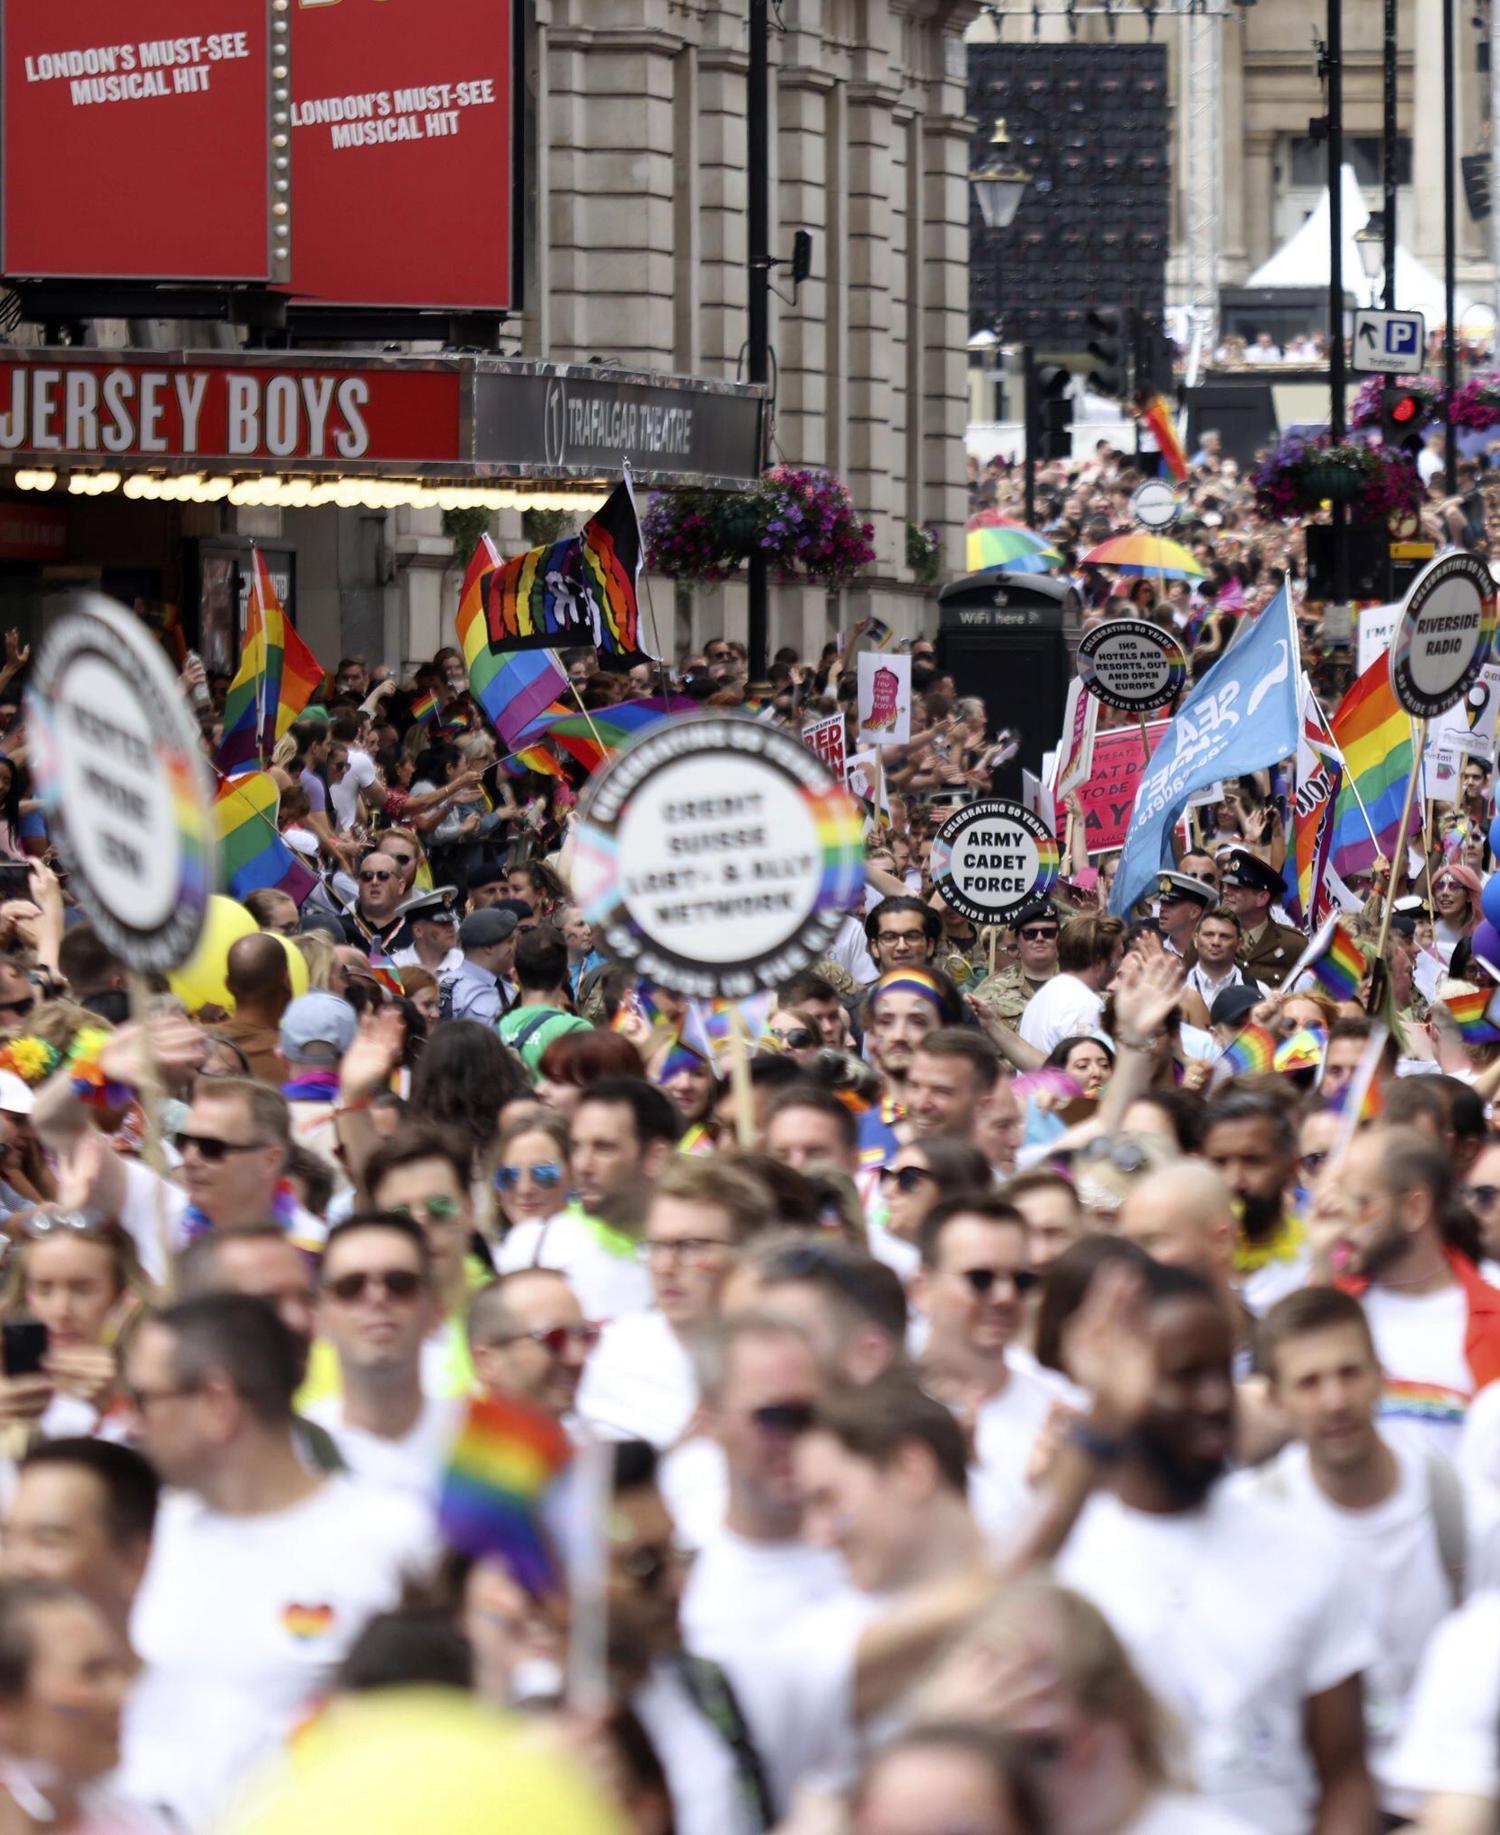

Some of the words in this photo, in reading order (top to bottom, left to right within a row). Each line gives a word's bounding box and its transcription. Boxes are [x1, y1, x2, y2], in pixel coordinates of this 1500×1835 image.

[24, 45, 136, 82] LONDON'S
[138, 32, 249, 68] MUST-SEE
[70, 70, 170, 106] MUSICAL
[172, 65, 210, 94] HIT
[290, 92, 390, 127] LONDON'S
[393, 79, 495, 114] MUST-SEE
[330, 115, 423, 149] MUSICAL
[424, 110, 460, 137] HIT
[1391, 322, 1412, 352] P
[0, 368, 208, 453] JERSEY
[227, 374, 370, 459] BOYS
[568, 398, 637, 450] TRAFALGAR
[639, 405, 693, 454] THEATRE
[959, 612, 989, 625] WiFi
[995, 612, 1025, 625] here
[1416, 613, 1480, 636] RIVERSIDE
[1098, 652, 1137, 661] HOTELS
[1140, 651, 1161, 659] AND
[1118, 642, 1137, 650] IHG
[1425, 637, 1463, 657] RADIO
[1095, 662, 1145, 671] RESORTS,
[1147, 661, 1168, 669] OUT
[1107, 672, 1129, 681] AND
[1131, 671, 1159, 680] OPEN
[1114, 681, 1157, 691] EUROPE
[803, 724, 842, 751] RED
[1082, 788, 1105, 800] TO
[1109, 782, 1129, 796] BE
[662, 793, 764, 823] CREDIT
[943, 803, 1005, 838] CELEBRATING
[1007, 804, 1022, 817] 50
[1022, 812, 1048, 841] YEARS
[669, 828, 765, 854] SUISSE
[967, 831, 1024, 848] ARMY
[751, 855, 812, 881] ALLY
[963, 854, 1027, 870] CADET
[963, 876, 1026, 893] FORCE
[655, 891, 794, 927] NETWORK
[941, 885, 954, 900] OF
[953, 900, 985, 922] PRIDE
[988, 914, 1001, 923] IN
